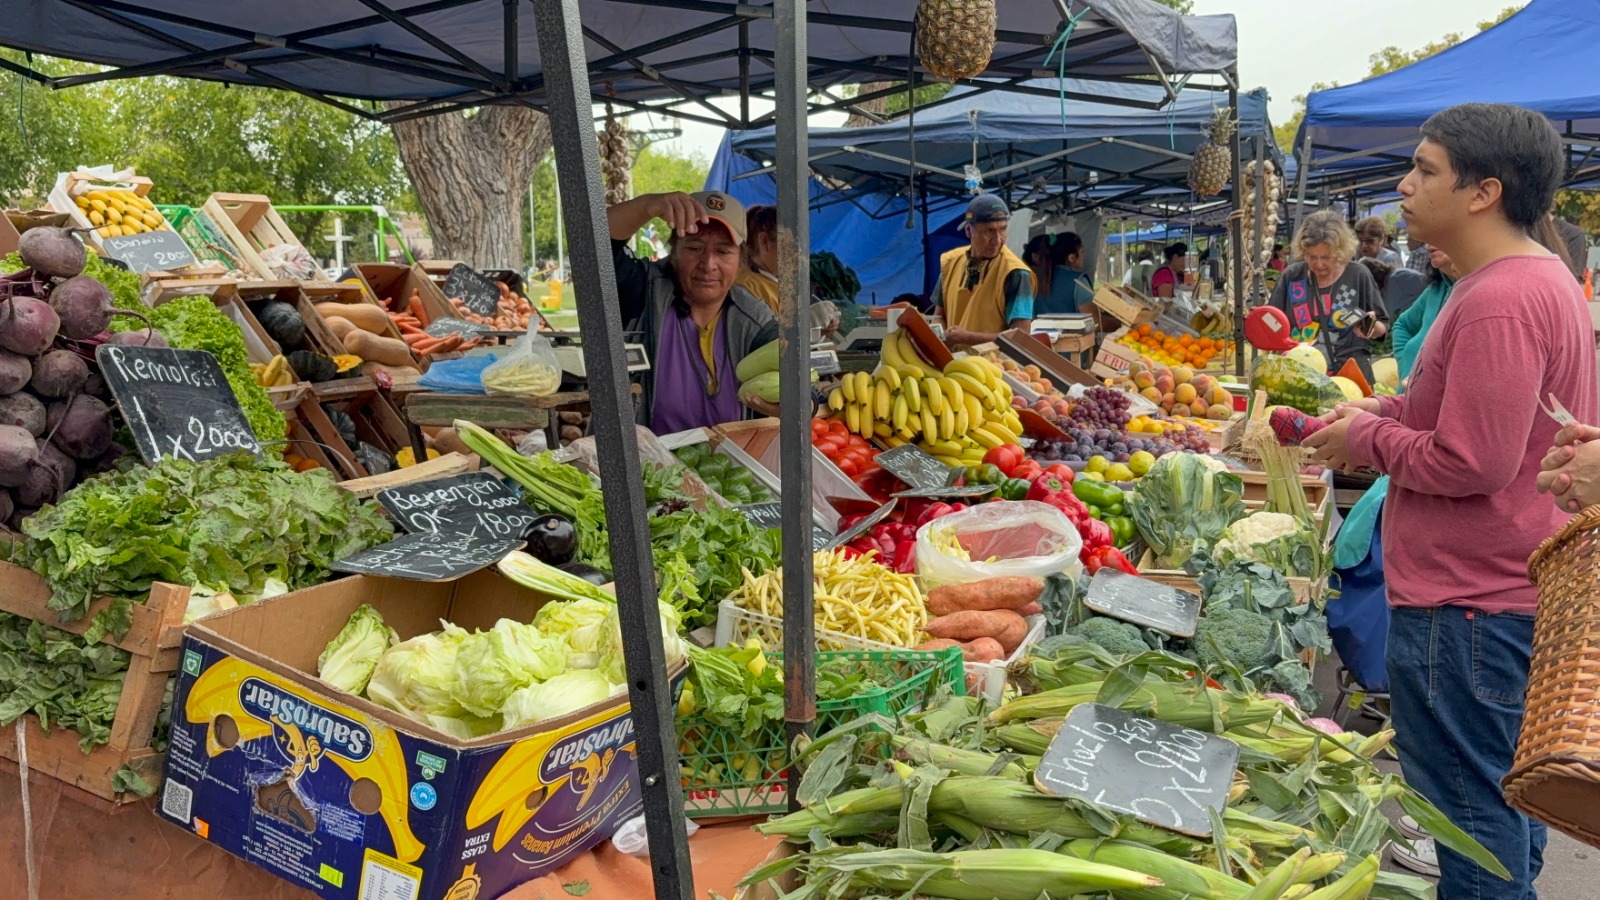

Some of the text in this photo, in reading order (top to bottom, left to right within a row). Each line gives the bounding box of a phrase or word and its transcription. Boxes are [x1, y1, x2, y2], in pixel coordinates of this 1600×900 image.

[1292, 282, 1305, 299] 5
[1297, 308, 1308, 324] 2
[465, 832, 490, 848] EXTRA
[461, 844, 487, 860] CLASS
